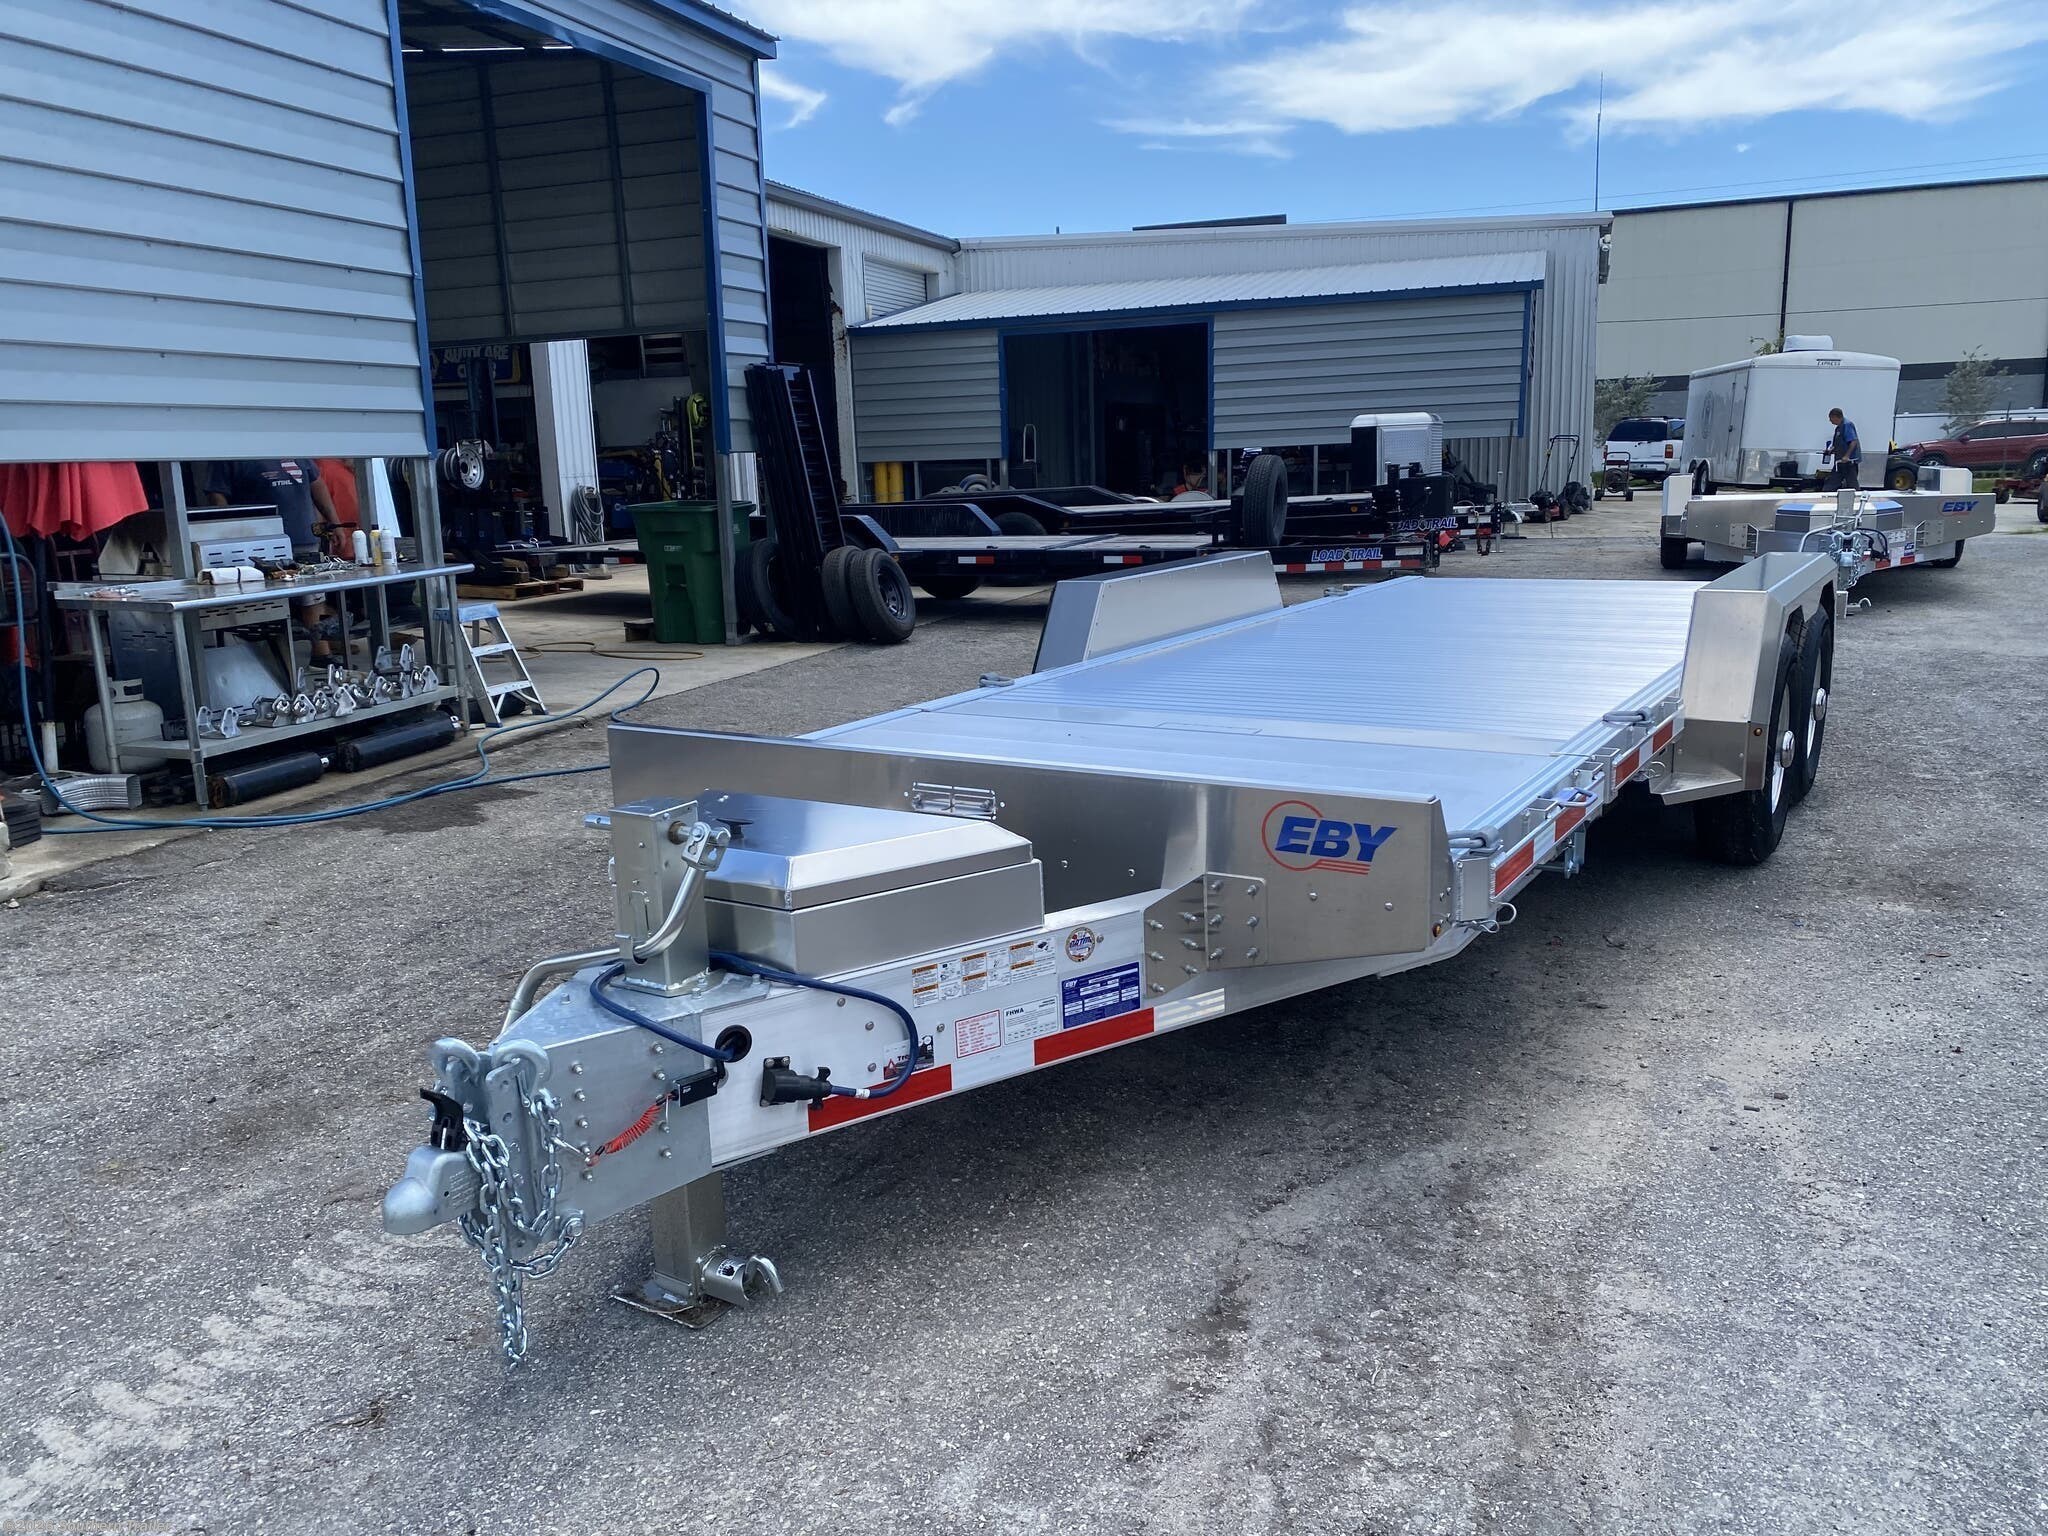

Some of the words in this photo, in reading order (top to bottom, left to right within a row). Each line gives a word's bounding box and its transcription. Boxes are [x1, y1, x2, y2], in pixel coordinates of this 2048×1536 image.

[1942, 501, 1979, 513] EBY
[1398, 519, 1420, 531] OAD
[1425, 517, 1458, 530] TRAIL
[1311, 549, 1344, 562] LOAD
[1350, 547, 1383, 560] TRAIL
[1275, 816, 1398, 862] EBY
[1005, 1007, 1025, 1016] FHWA
